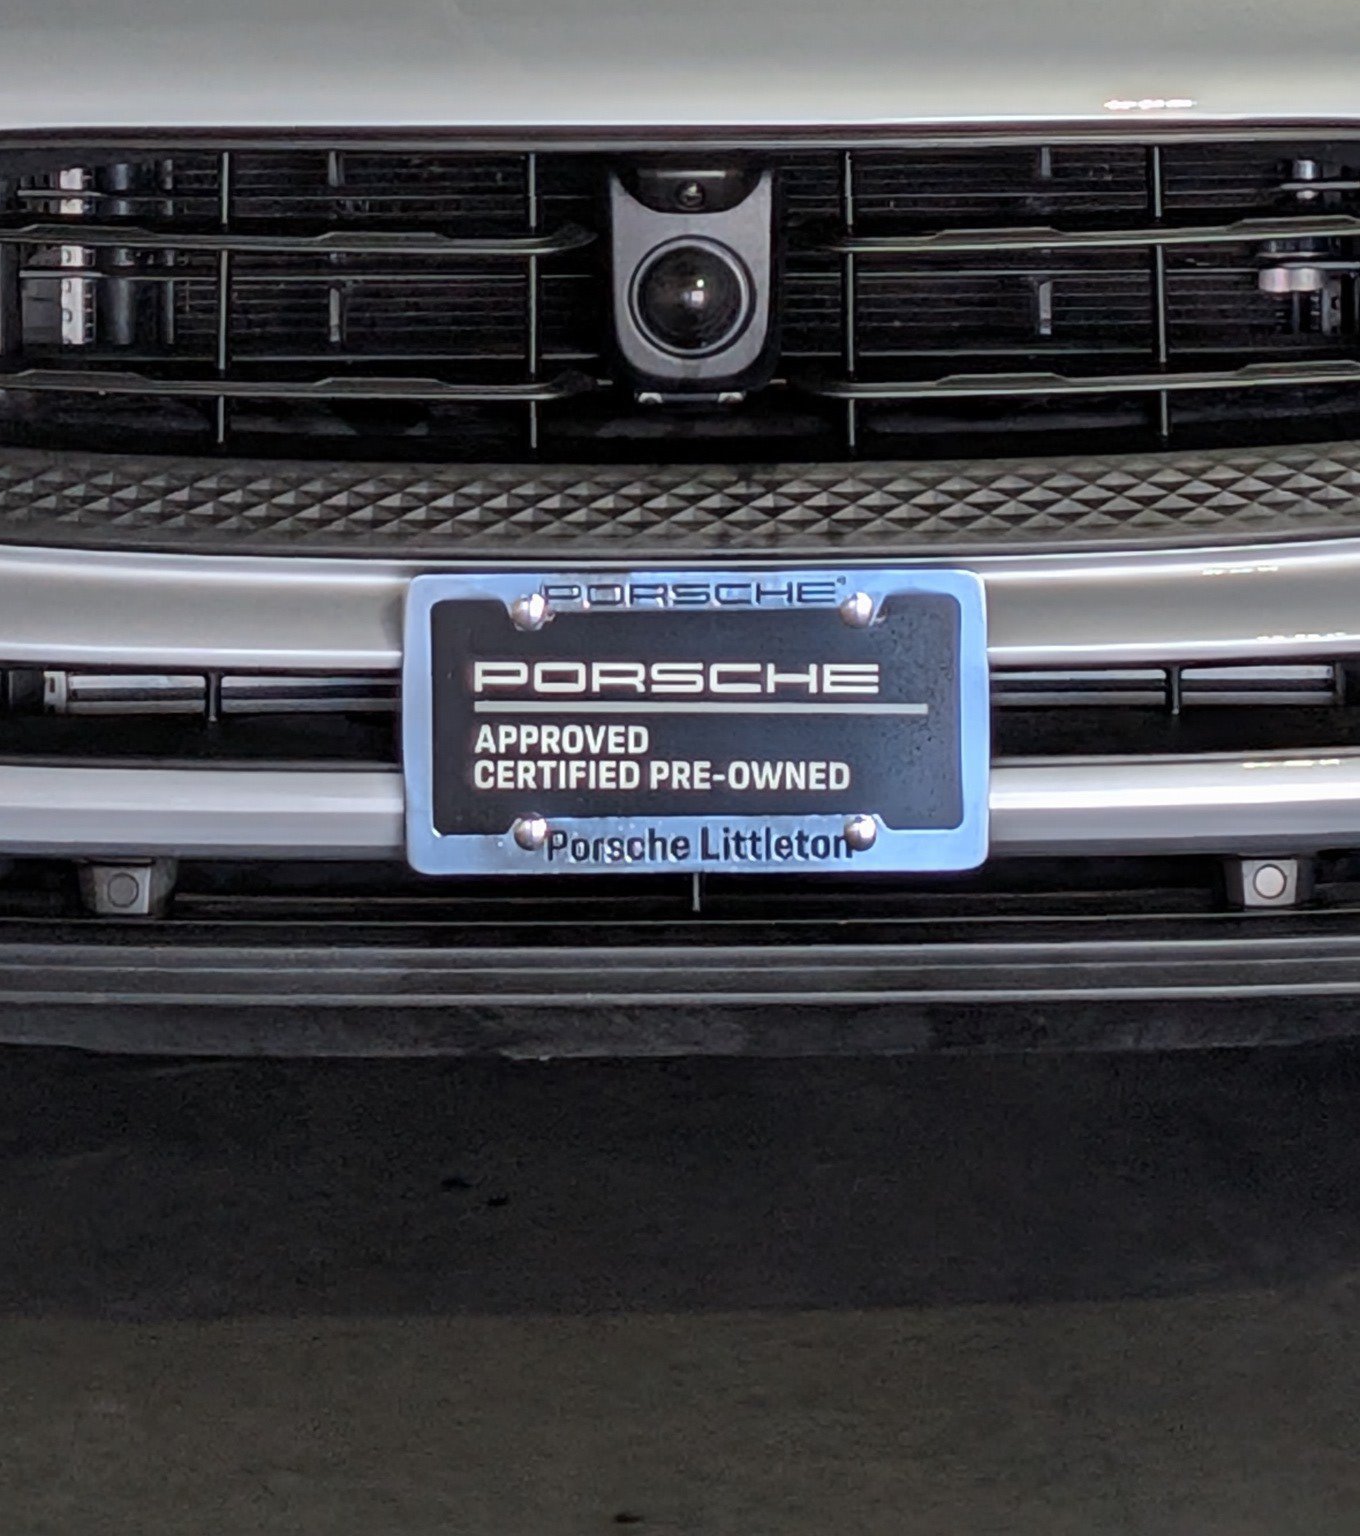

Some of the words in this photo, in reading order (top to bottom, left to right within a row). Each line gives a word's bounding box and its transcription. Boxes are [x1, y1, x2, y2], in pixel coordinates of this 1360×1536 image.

[543, 580, 837, 606] PORSCHE
[474, 662, 879, 694] PORSCHE
[474, 725, 649, 754] APPROVED
[474, 760, 640, 790] CERTIFIED
[650, 761, 850, 790] PRE-OWNED
[546, 828, 690, 861] Porsche
[700, 827, 853, 860] Littleton
